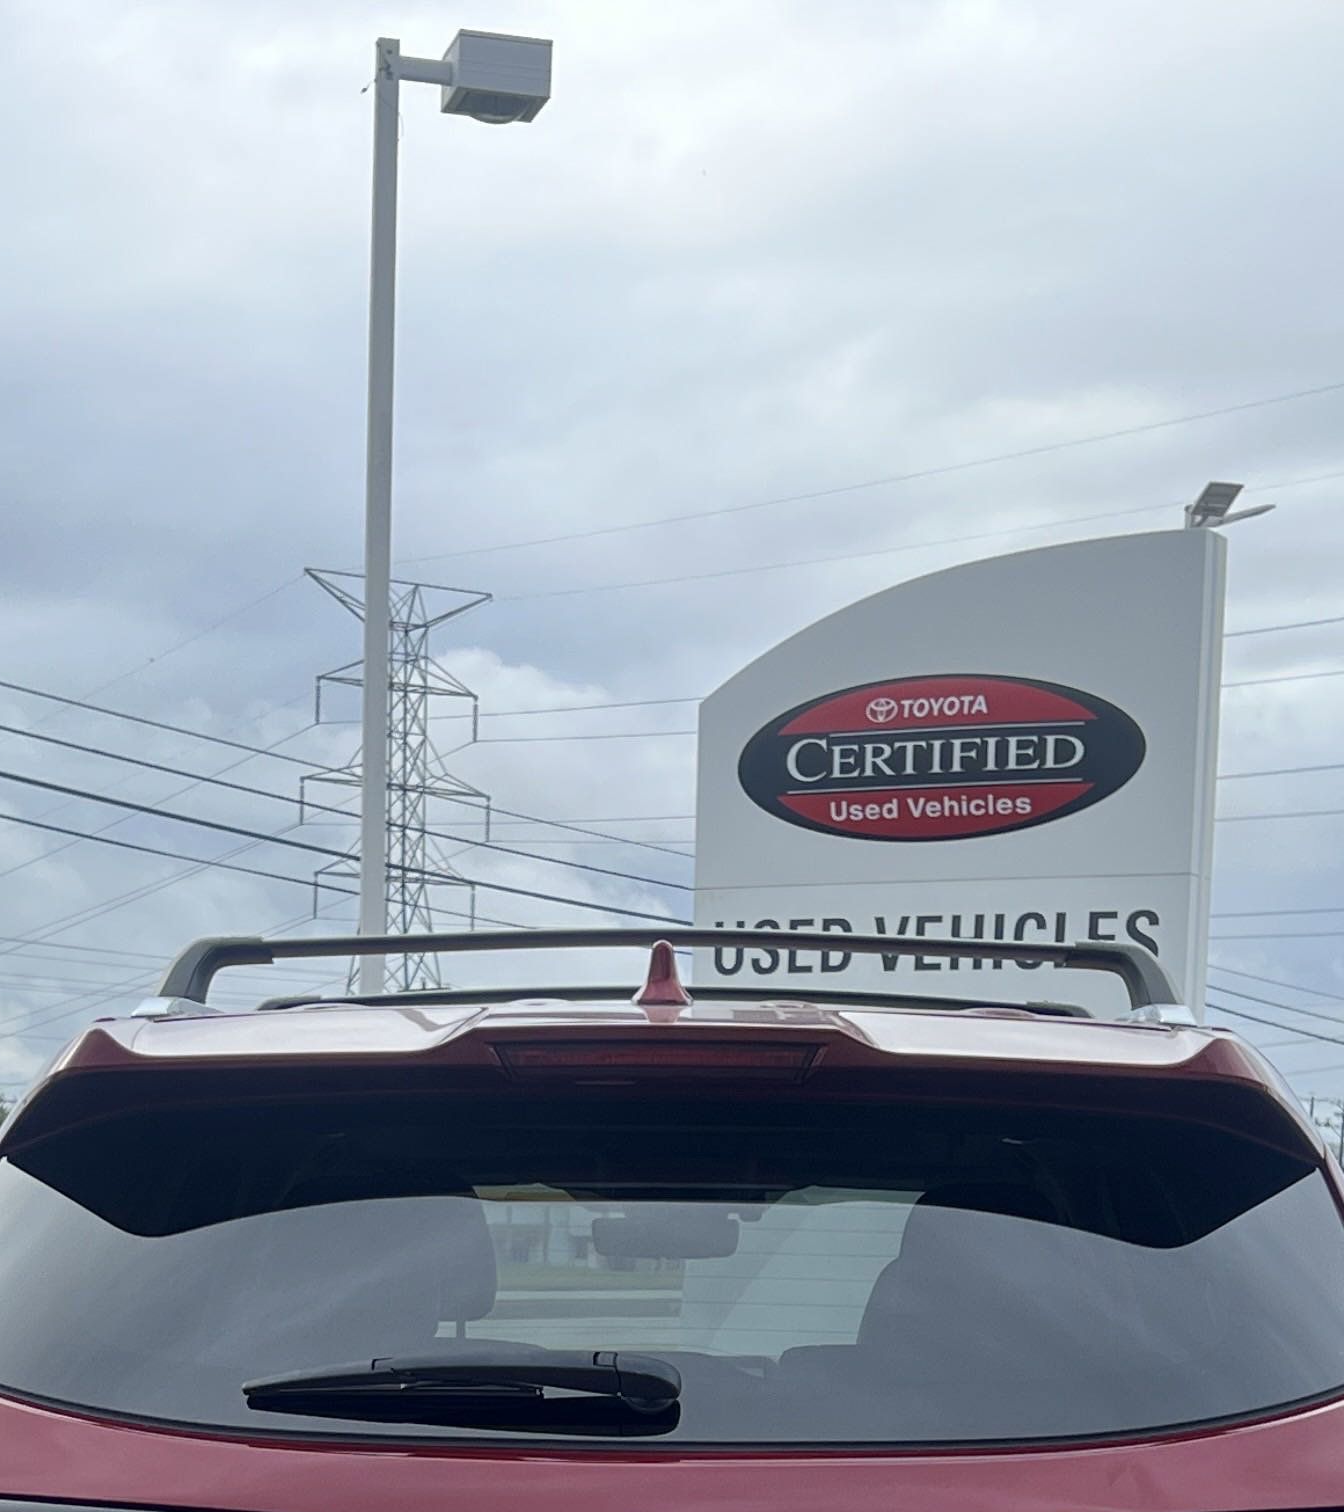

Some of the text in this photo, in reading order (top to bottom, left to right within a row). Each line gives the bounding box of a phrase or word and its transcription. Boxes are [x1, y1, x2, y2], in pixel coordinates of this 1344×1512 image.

[901, 695, 988, 718] TOYOTA
[786, 734, 1085, 783] CERTIFIED
[830, 794, 1032, 822] Used Vehicles
